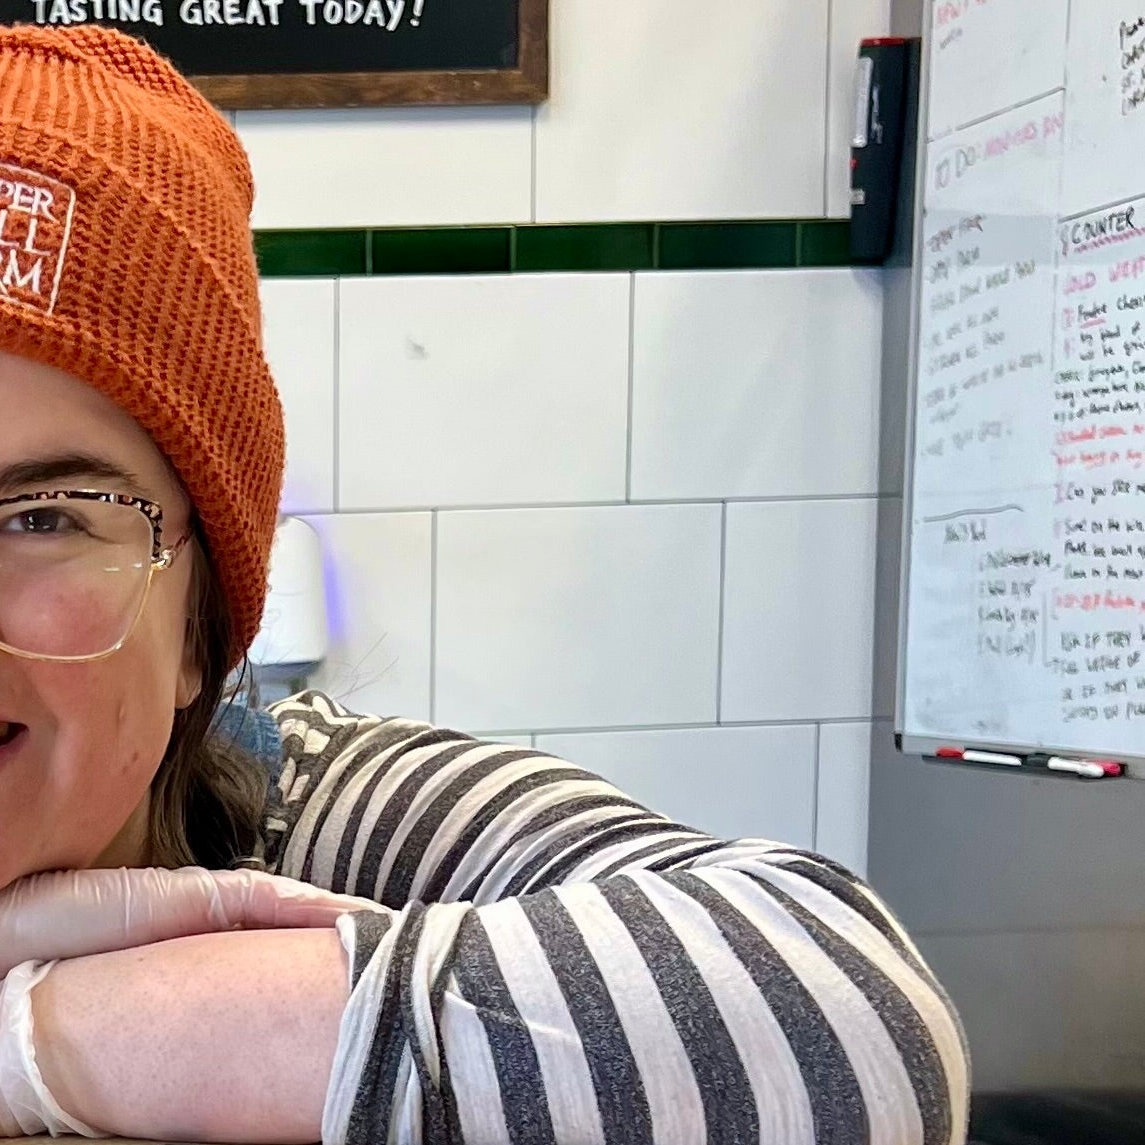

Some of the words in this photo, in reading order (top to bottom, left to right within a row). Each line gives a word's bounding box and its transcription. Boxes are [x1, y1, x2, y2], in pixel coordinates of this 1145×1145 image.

[32, 0, 163, 26] TASTING
[179, 0, 281, 26] GREAT
[299, 0, 425, 31] TODAY!
